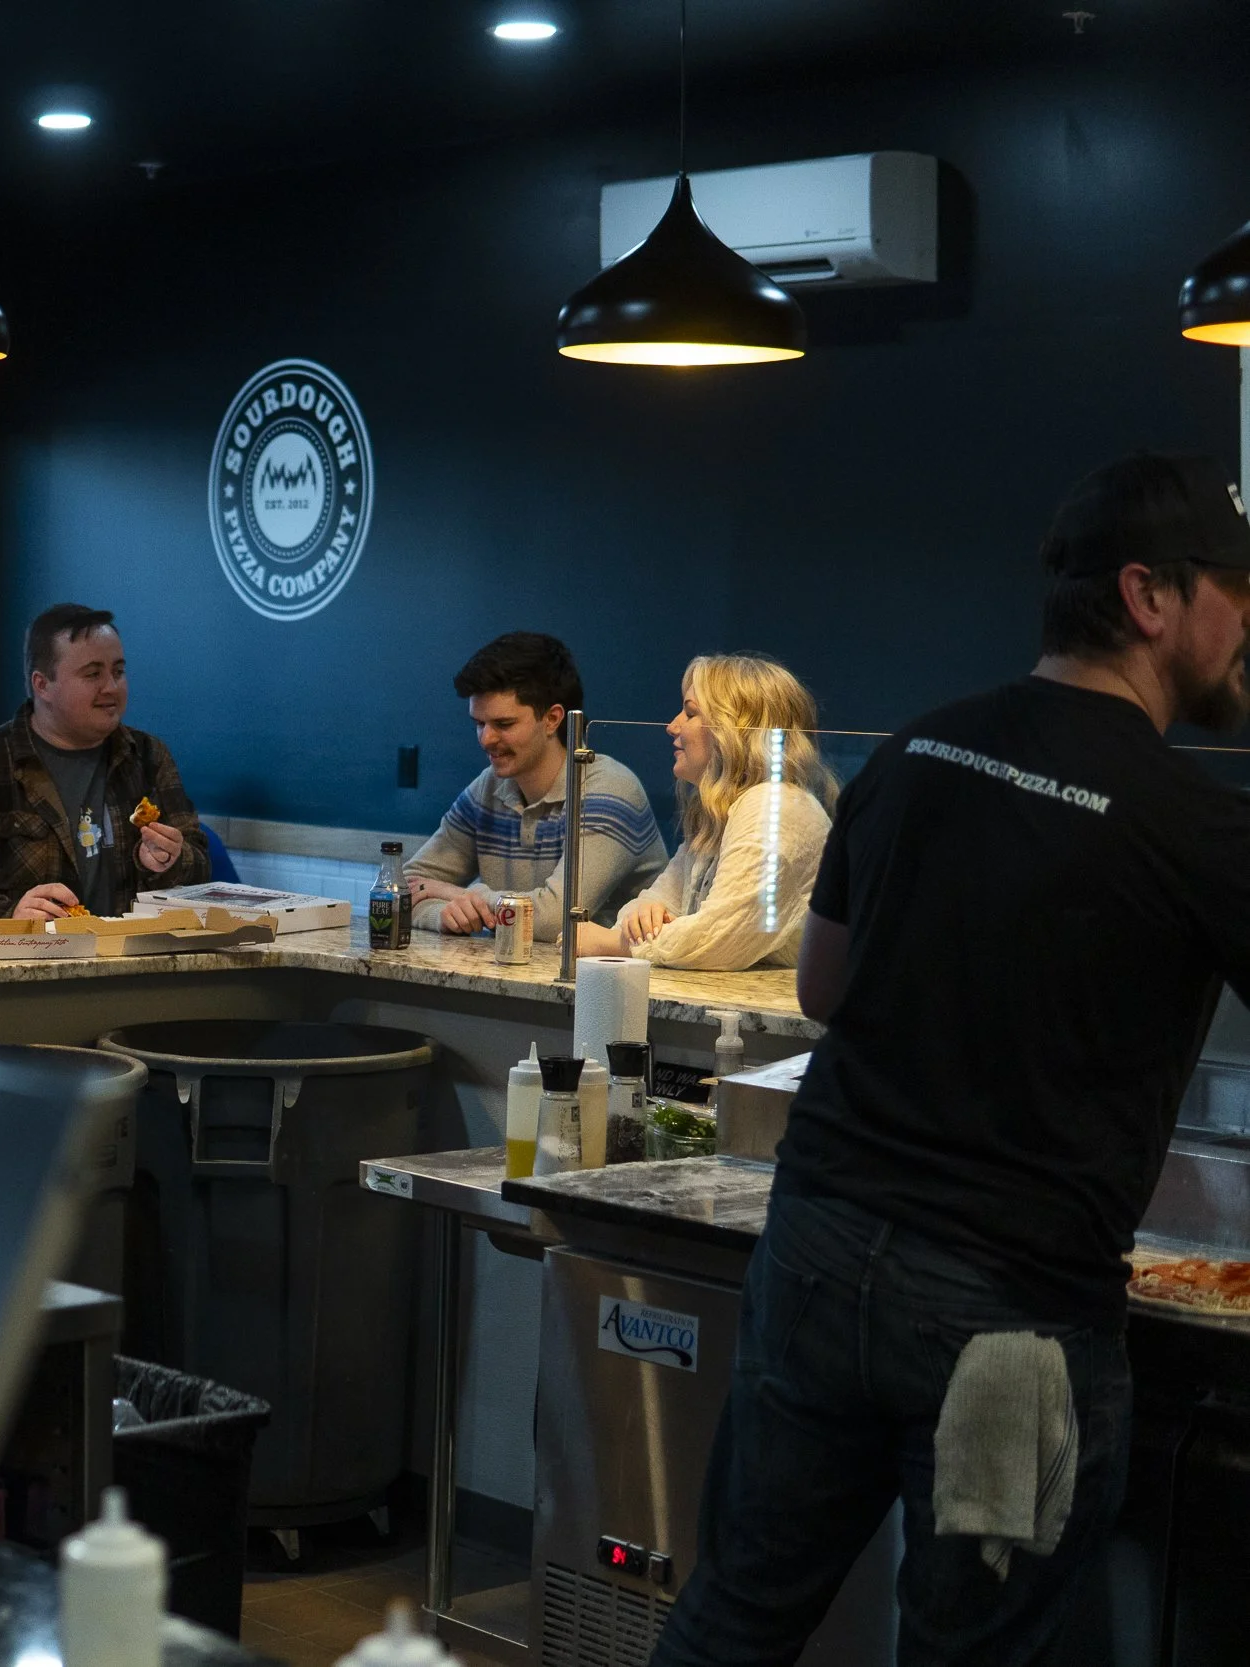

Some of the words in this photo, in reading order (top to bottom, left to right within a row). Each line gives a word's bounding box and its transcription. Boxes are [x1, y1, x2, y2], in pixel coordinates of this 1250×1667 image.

[224, 382, 357, 476] SOURDOUGH
[224, 506, 265, 589] PIZZA
[268, 505, 356, 599] COMPANY
[372, 901, 390, 909] PURE
[372, 907, 390, 915] LEAF
[601, 1303, 694, 1351] AVANTCO
